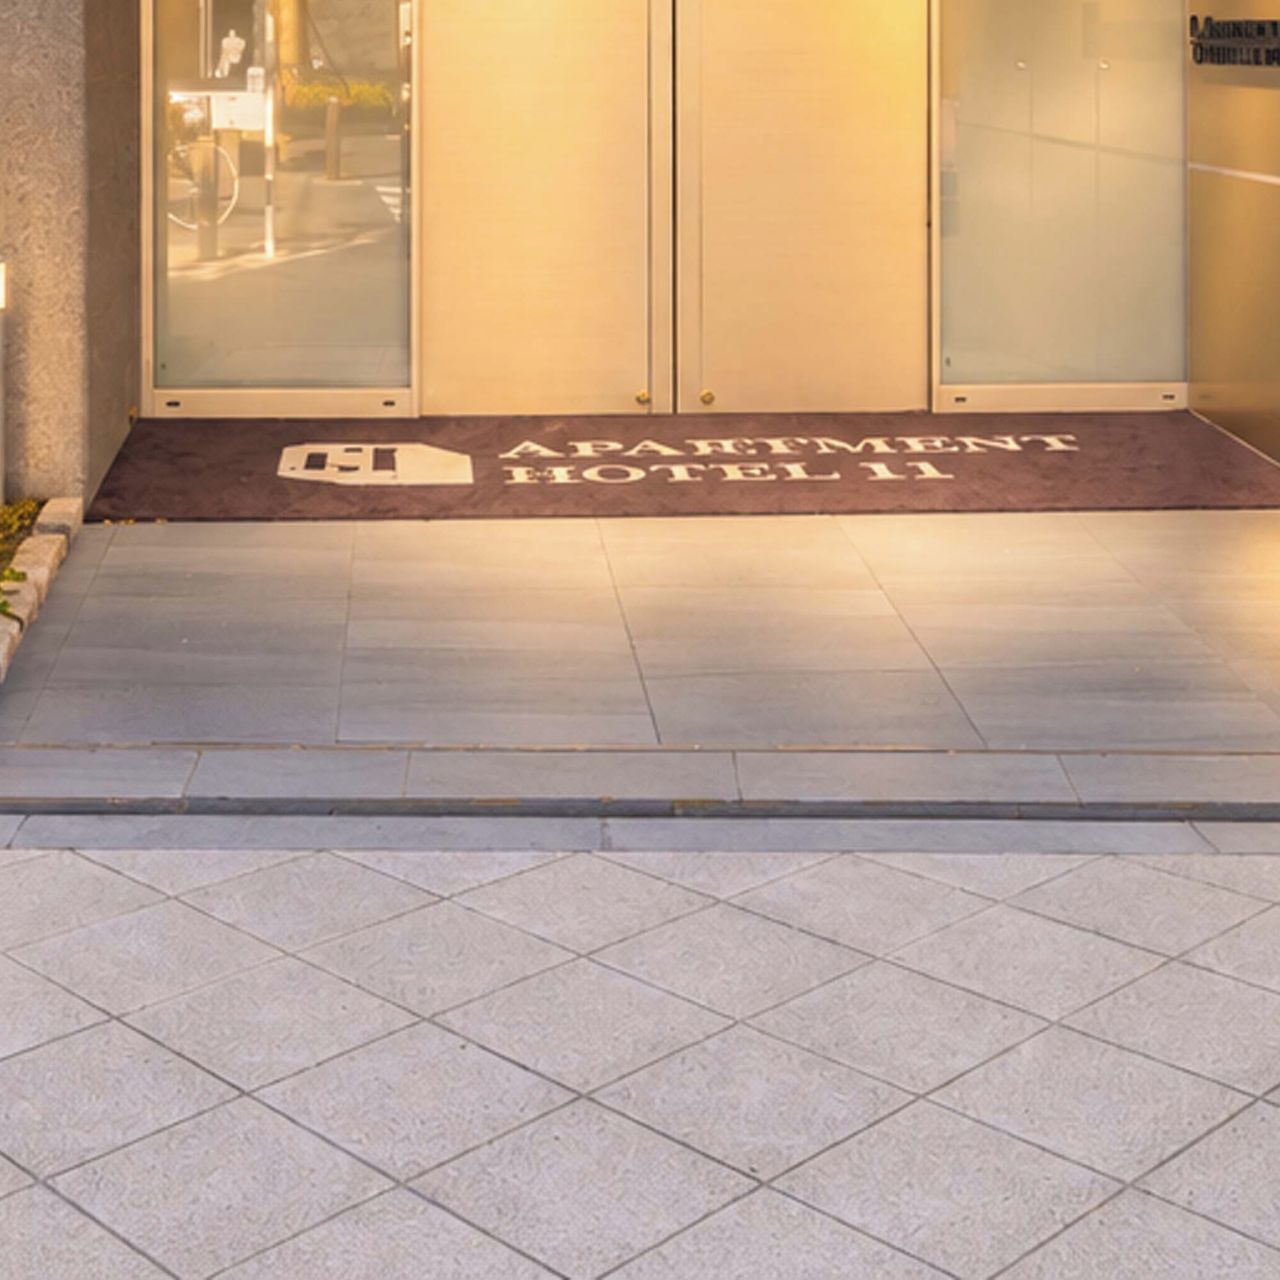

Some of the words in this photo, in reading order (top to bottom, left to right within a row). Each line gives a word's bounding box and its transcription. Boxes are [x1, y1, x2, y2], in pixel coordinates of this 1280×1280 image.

[498, 433, 1080, 459] APARTMENT
[503, 461, 841, 485] HOTEL
[859, 461, 955, 481] 11
